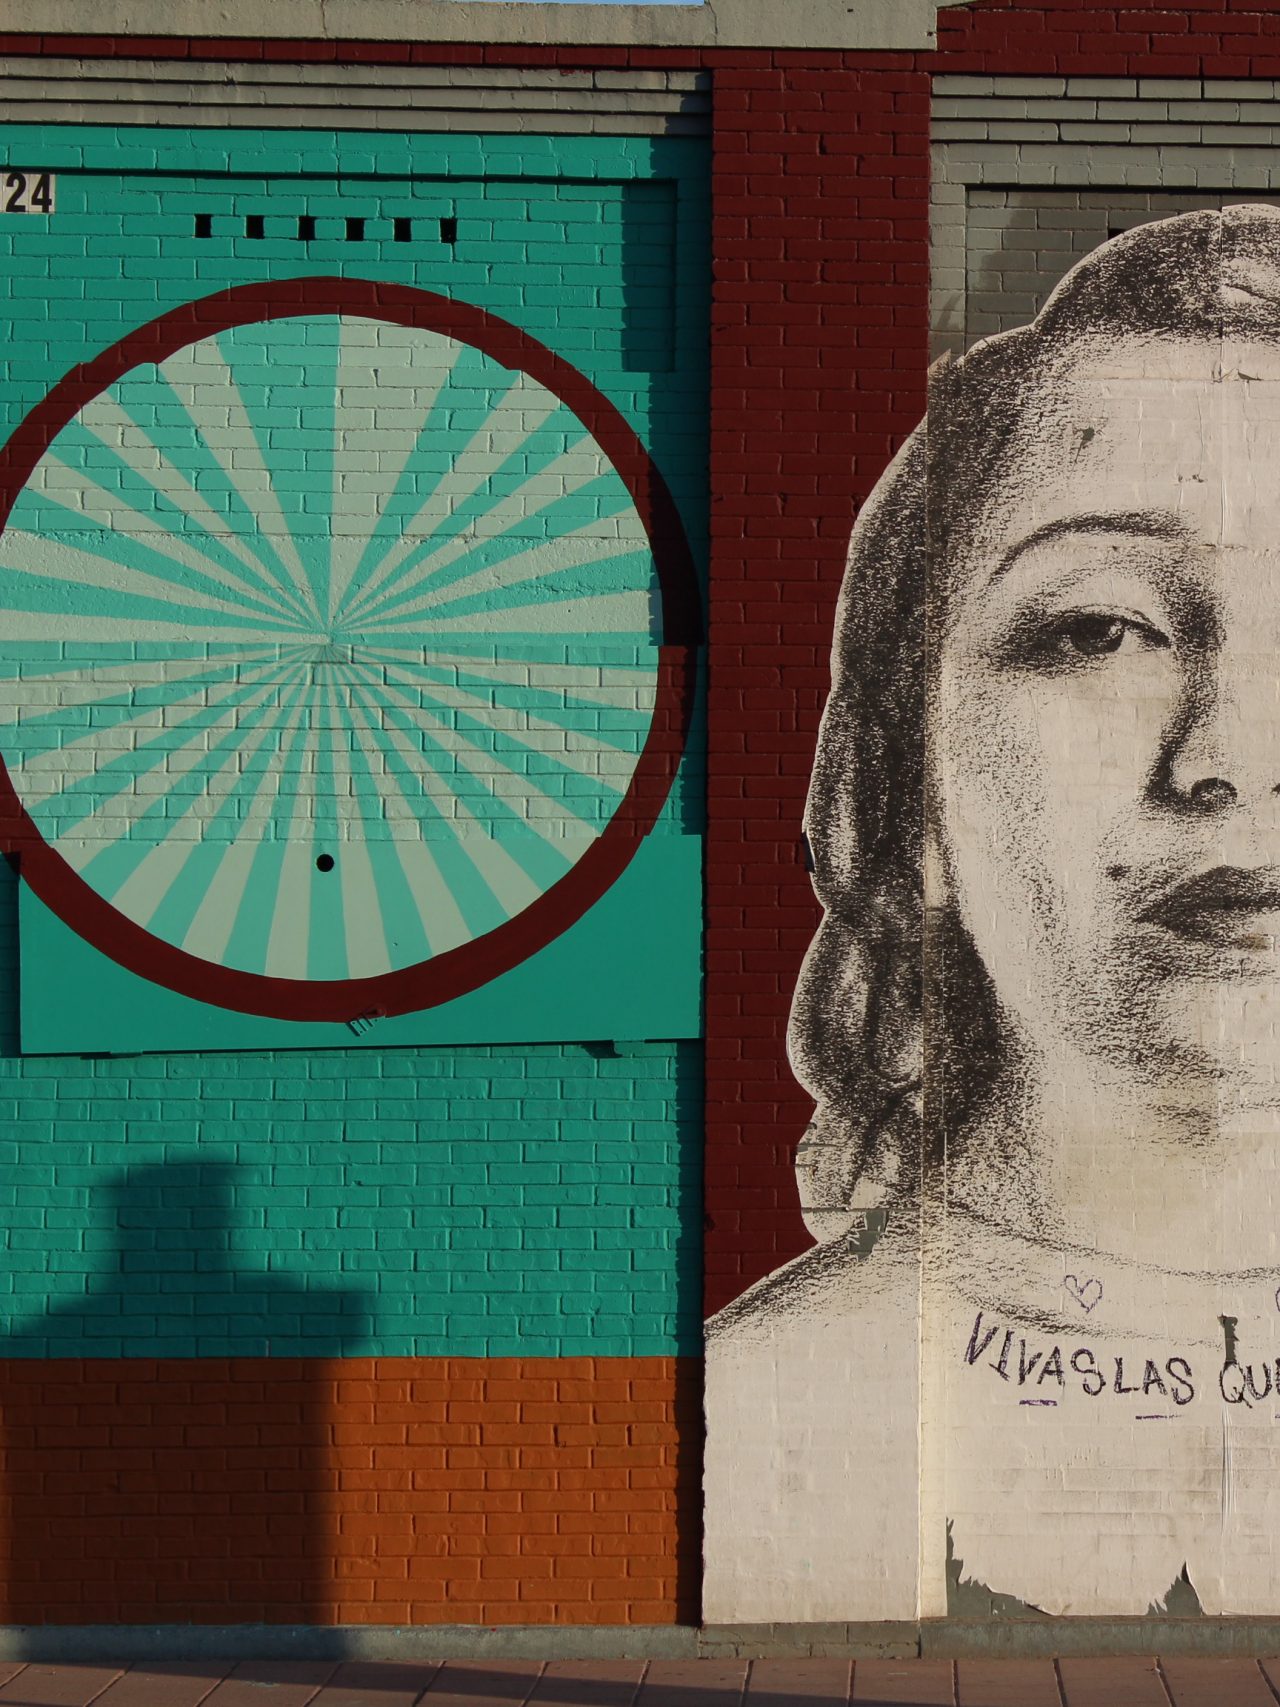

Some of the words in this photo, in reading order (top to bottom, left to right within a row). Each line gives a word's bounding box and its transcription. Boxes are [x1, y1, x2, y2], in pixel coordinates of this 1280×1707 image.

[6, 172, 53, 213] 24
[963, 1310, 1107, 1397] VIVAS
[1113, 1355, 1196, 1406] LAS
